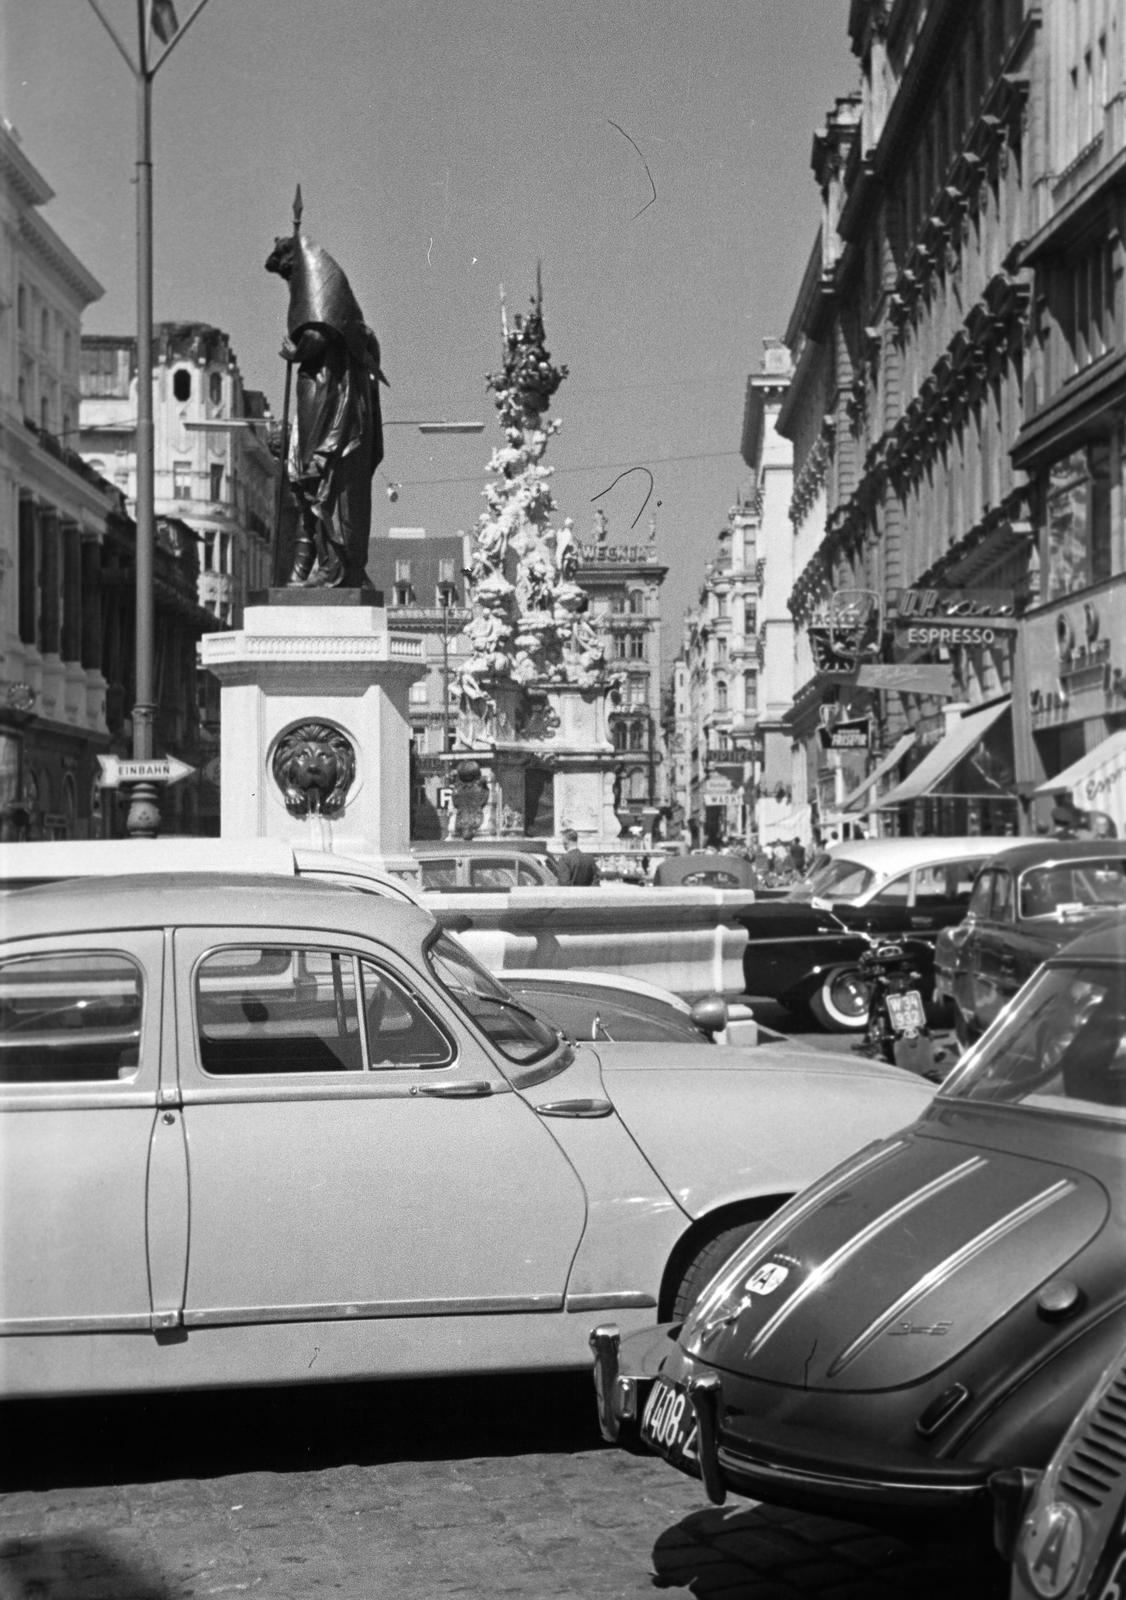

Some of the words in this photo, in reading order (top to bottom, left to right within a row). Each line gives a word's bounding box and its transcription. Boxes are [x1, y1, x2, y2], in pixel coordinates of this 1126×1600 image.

[907, 628, 994, 644] ESPRESSO
[118, 765, 170, 776] EINBAHN
[1033, 1510, 1072, 1588] A
